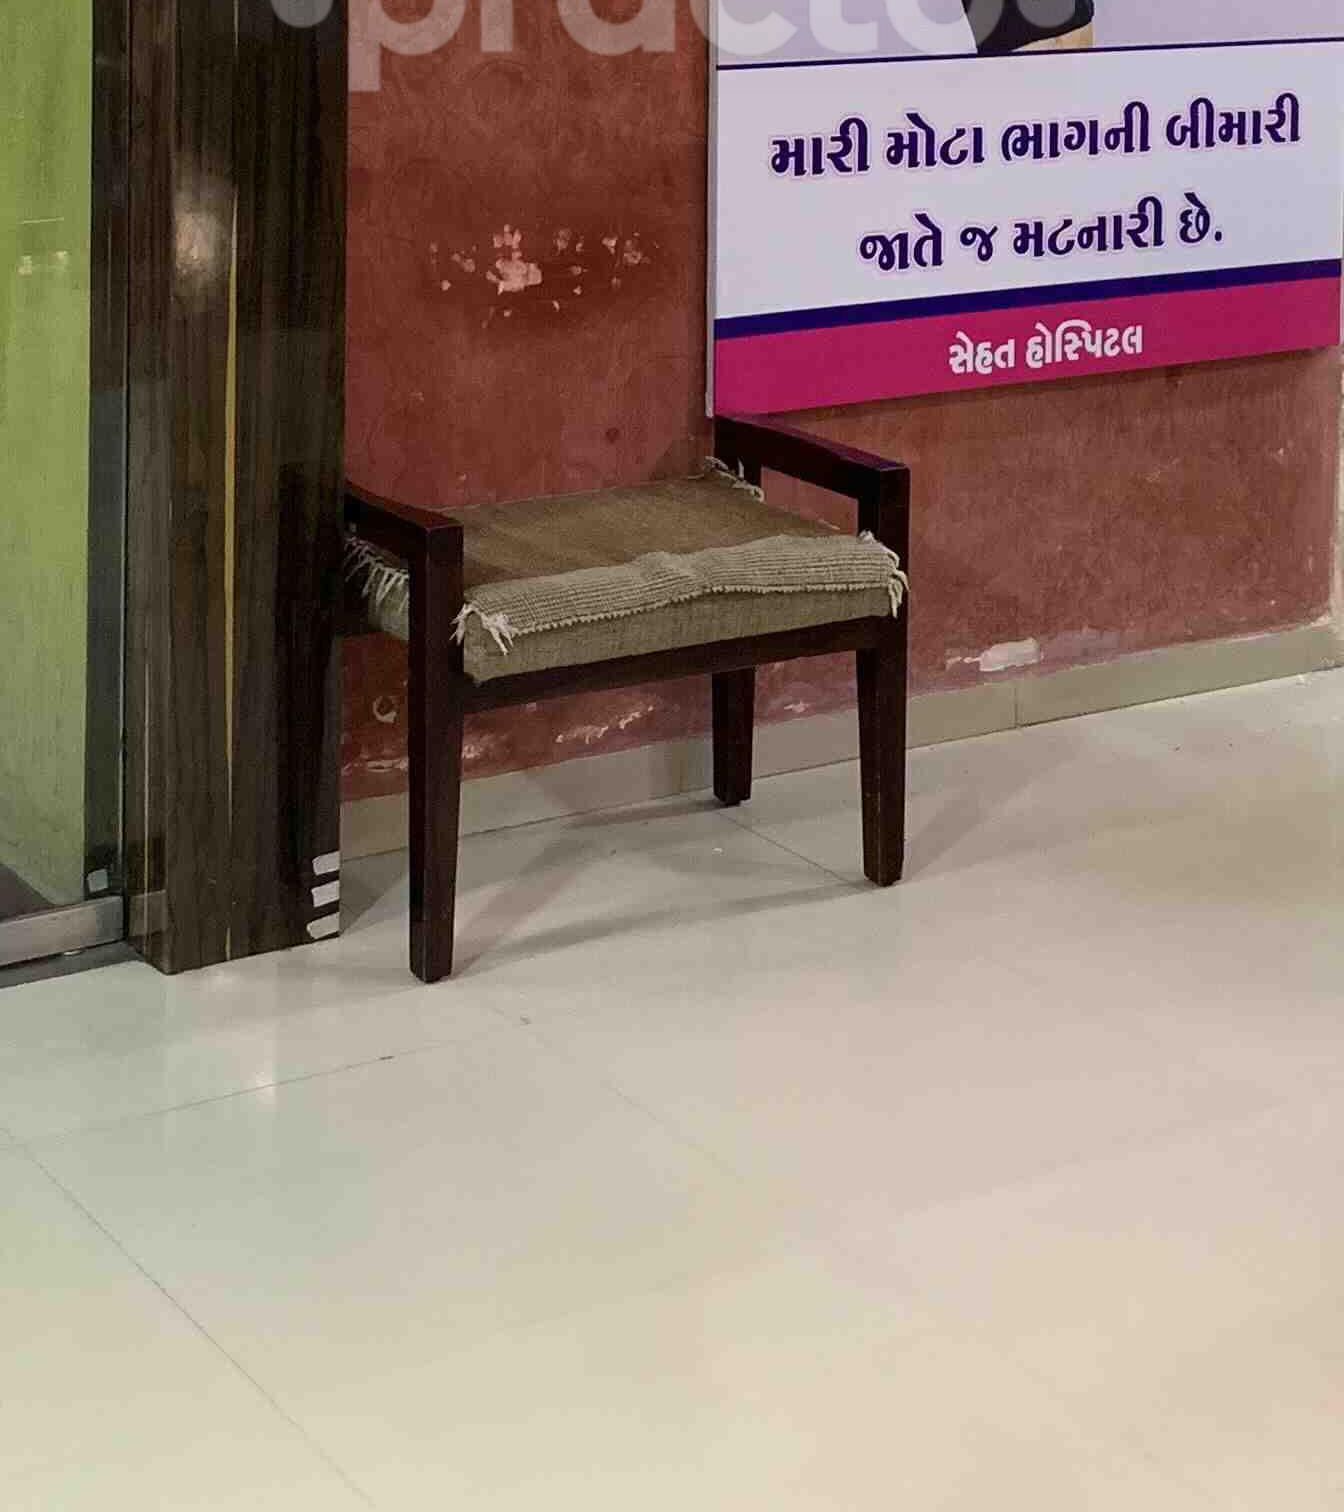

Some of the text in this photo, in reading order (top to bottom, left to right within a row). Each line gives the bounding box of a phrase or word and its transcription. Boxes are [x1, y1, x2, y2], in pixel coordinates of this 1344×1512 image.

[771, 93, 1300, 177] મારી મોટા ભાગની બીમારી
[860, 193, 1223, 271] જાતે જ મટનારી છે.
[949, 320, 1144, 375] સેહત હોસ્પિટલ
